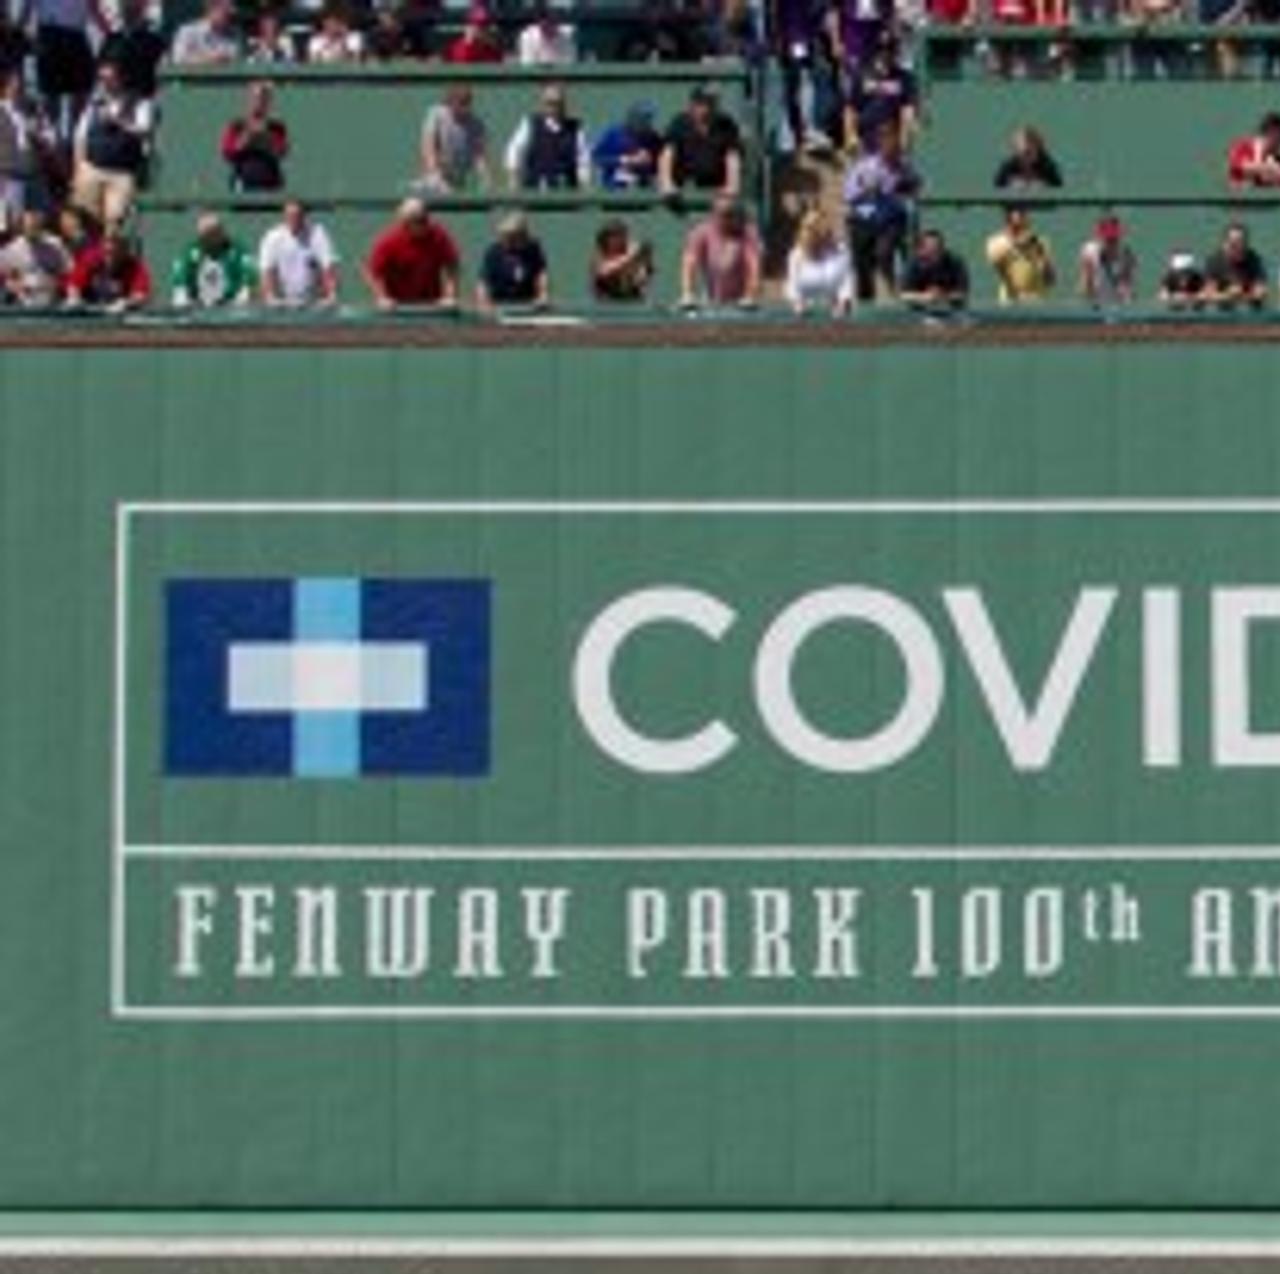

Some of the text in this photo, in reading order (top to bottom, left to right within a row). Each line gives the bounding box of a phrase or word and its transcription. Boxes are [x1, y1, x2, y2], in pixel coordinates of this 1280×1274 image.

[177, 886, 569, 977] FENWAY
[628, 888, 860, 978] PARK
[912, 885, 1139, 977] 100th
